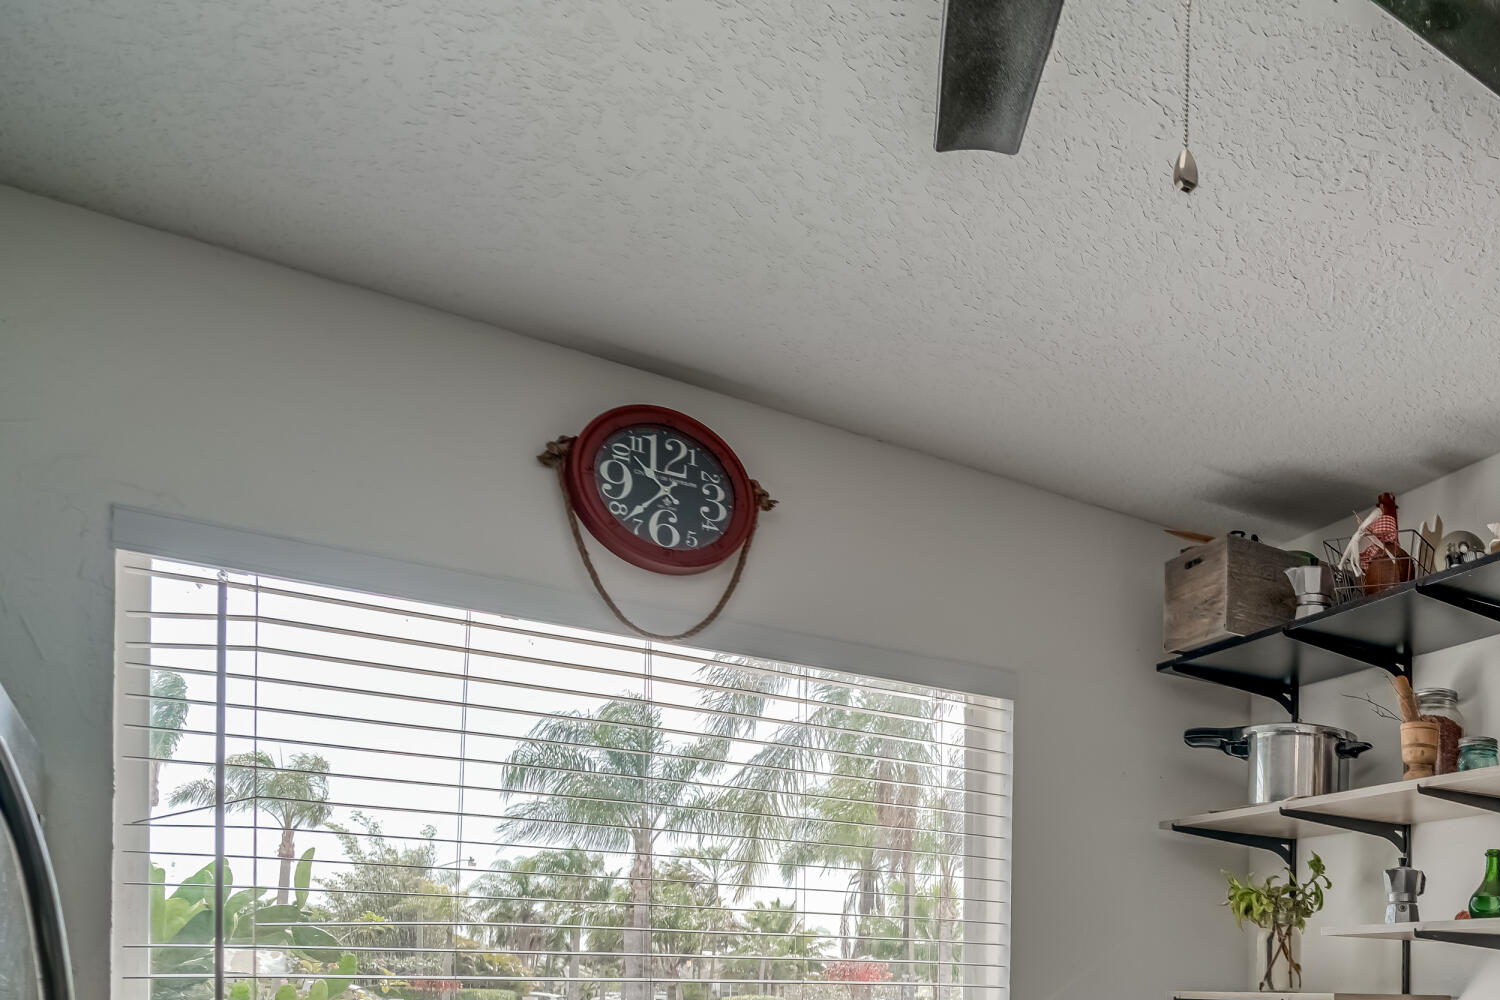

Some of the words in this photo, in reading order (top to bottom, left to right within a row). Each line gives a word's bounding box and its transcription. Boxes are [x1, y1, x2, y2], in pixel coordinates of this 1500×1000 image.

[611, 442, 631, 463] 10
[629, 435, 645, 454] 11
[642, 434, 688, 478] 12
[687, 448, 698, 467] 1
[600, 459, 633, 499] 9
[701, 470, 720, 484] 2
[609, 501, 628, 515] 8
[700, 483, 727, 521] 3
[632, 518, 643, 535] 7
[649, 509, 680, 547] 6
[702, 519, 719, 532] 4
[686, 530, 698, 547] 5
